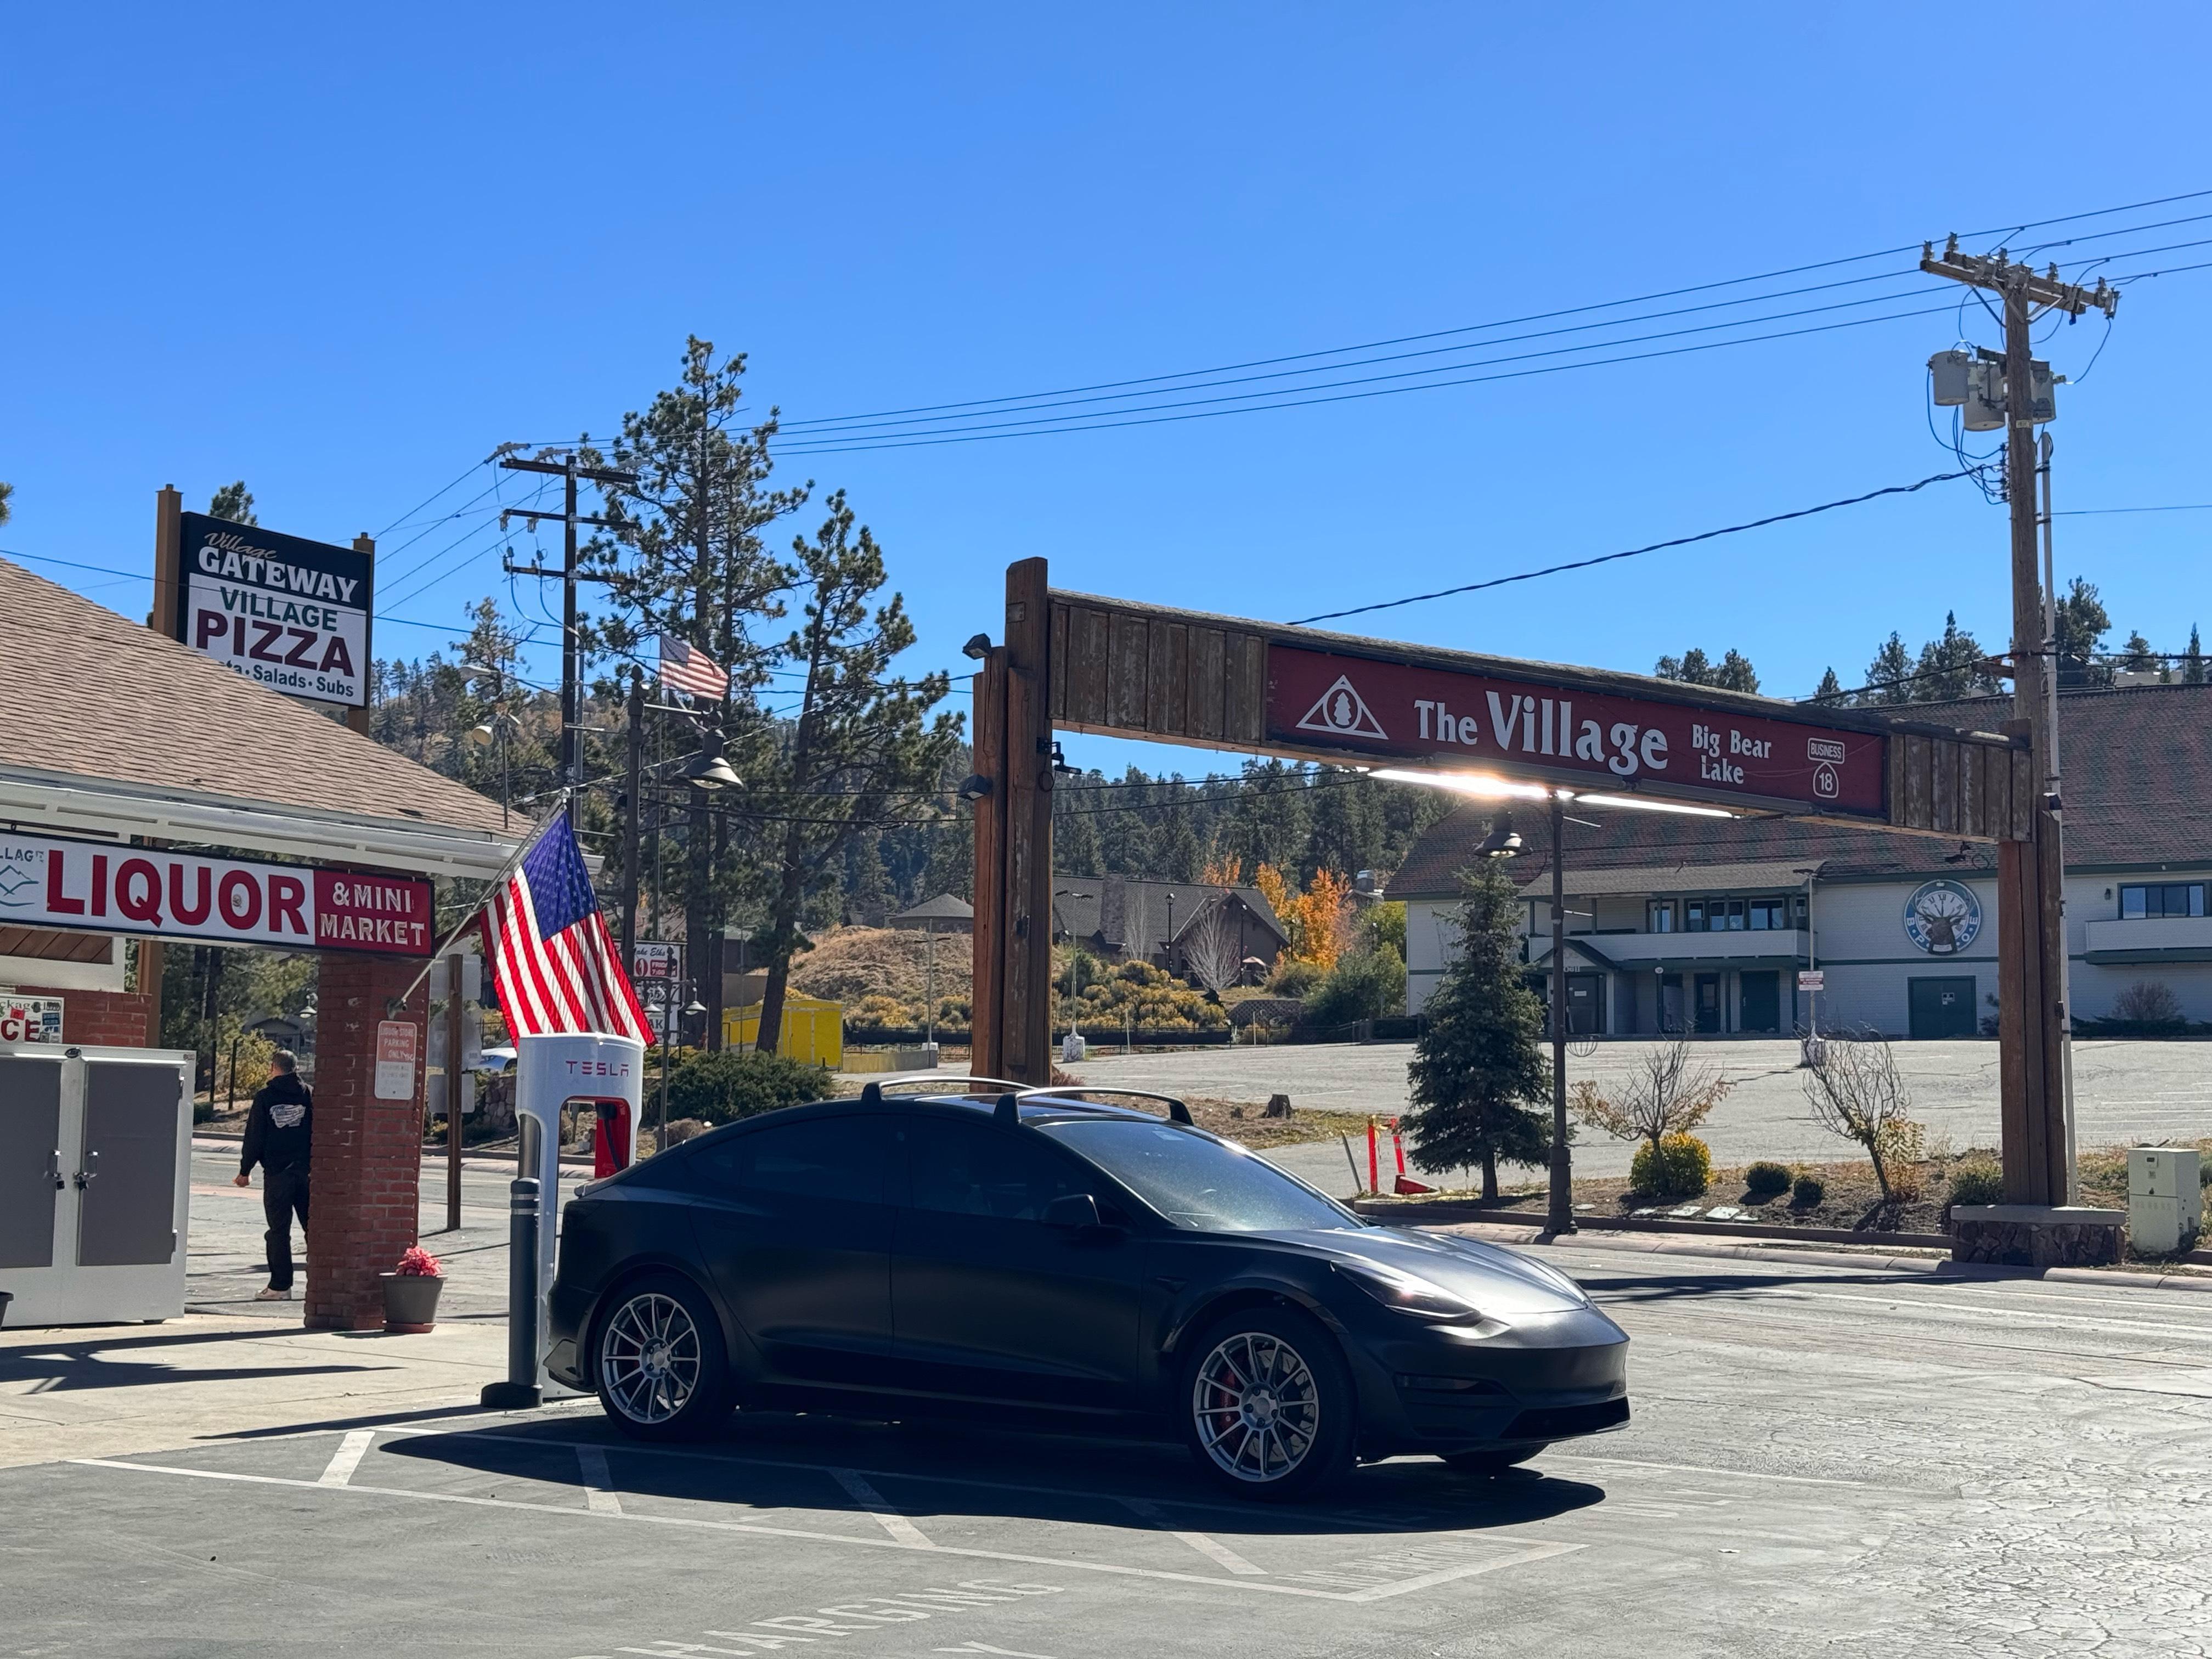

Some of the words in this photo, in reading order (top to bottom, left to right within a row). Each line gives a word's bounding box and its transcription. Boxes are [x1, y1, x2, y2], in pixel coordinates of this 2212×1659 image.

[204, 532, 277, 562] Village
[198, 546, 359, 603] GATEWAY
[220, 586, 338, 632] VILLAGE
[196, 608, 355, 678] PIZZA
[253, 664, 306, 689] Salads
[316, 676, 354, 697] Subs
[1414, 699, 1479, 746] The
[1485, 690, 1668, 776] Village
[1692, 724, 1721, 758] Big
[1730, 729, 1772, 759] Bear
[1810, 742, 1842, 759] BUSINESS
[1701, 755, 1744, 785] Lake
[1819, 772, 1833, 792] 18
[47, 849, 309, 934] LIQUOR
[320, 913, 425, 946] MARKET
[650, 947, 665, 956] Elks
[1, 1019, 41, 1042] CE
[384, 1038, 409, 1048] PARKING
[566, 1060, 629, 1077] TESLA
[568, 1579, 1065, 1659] HARGING
